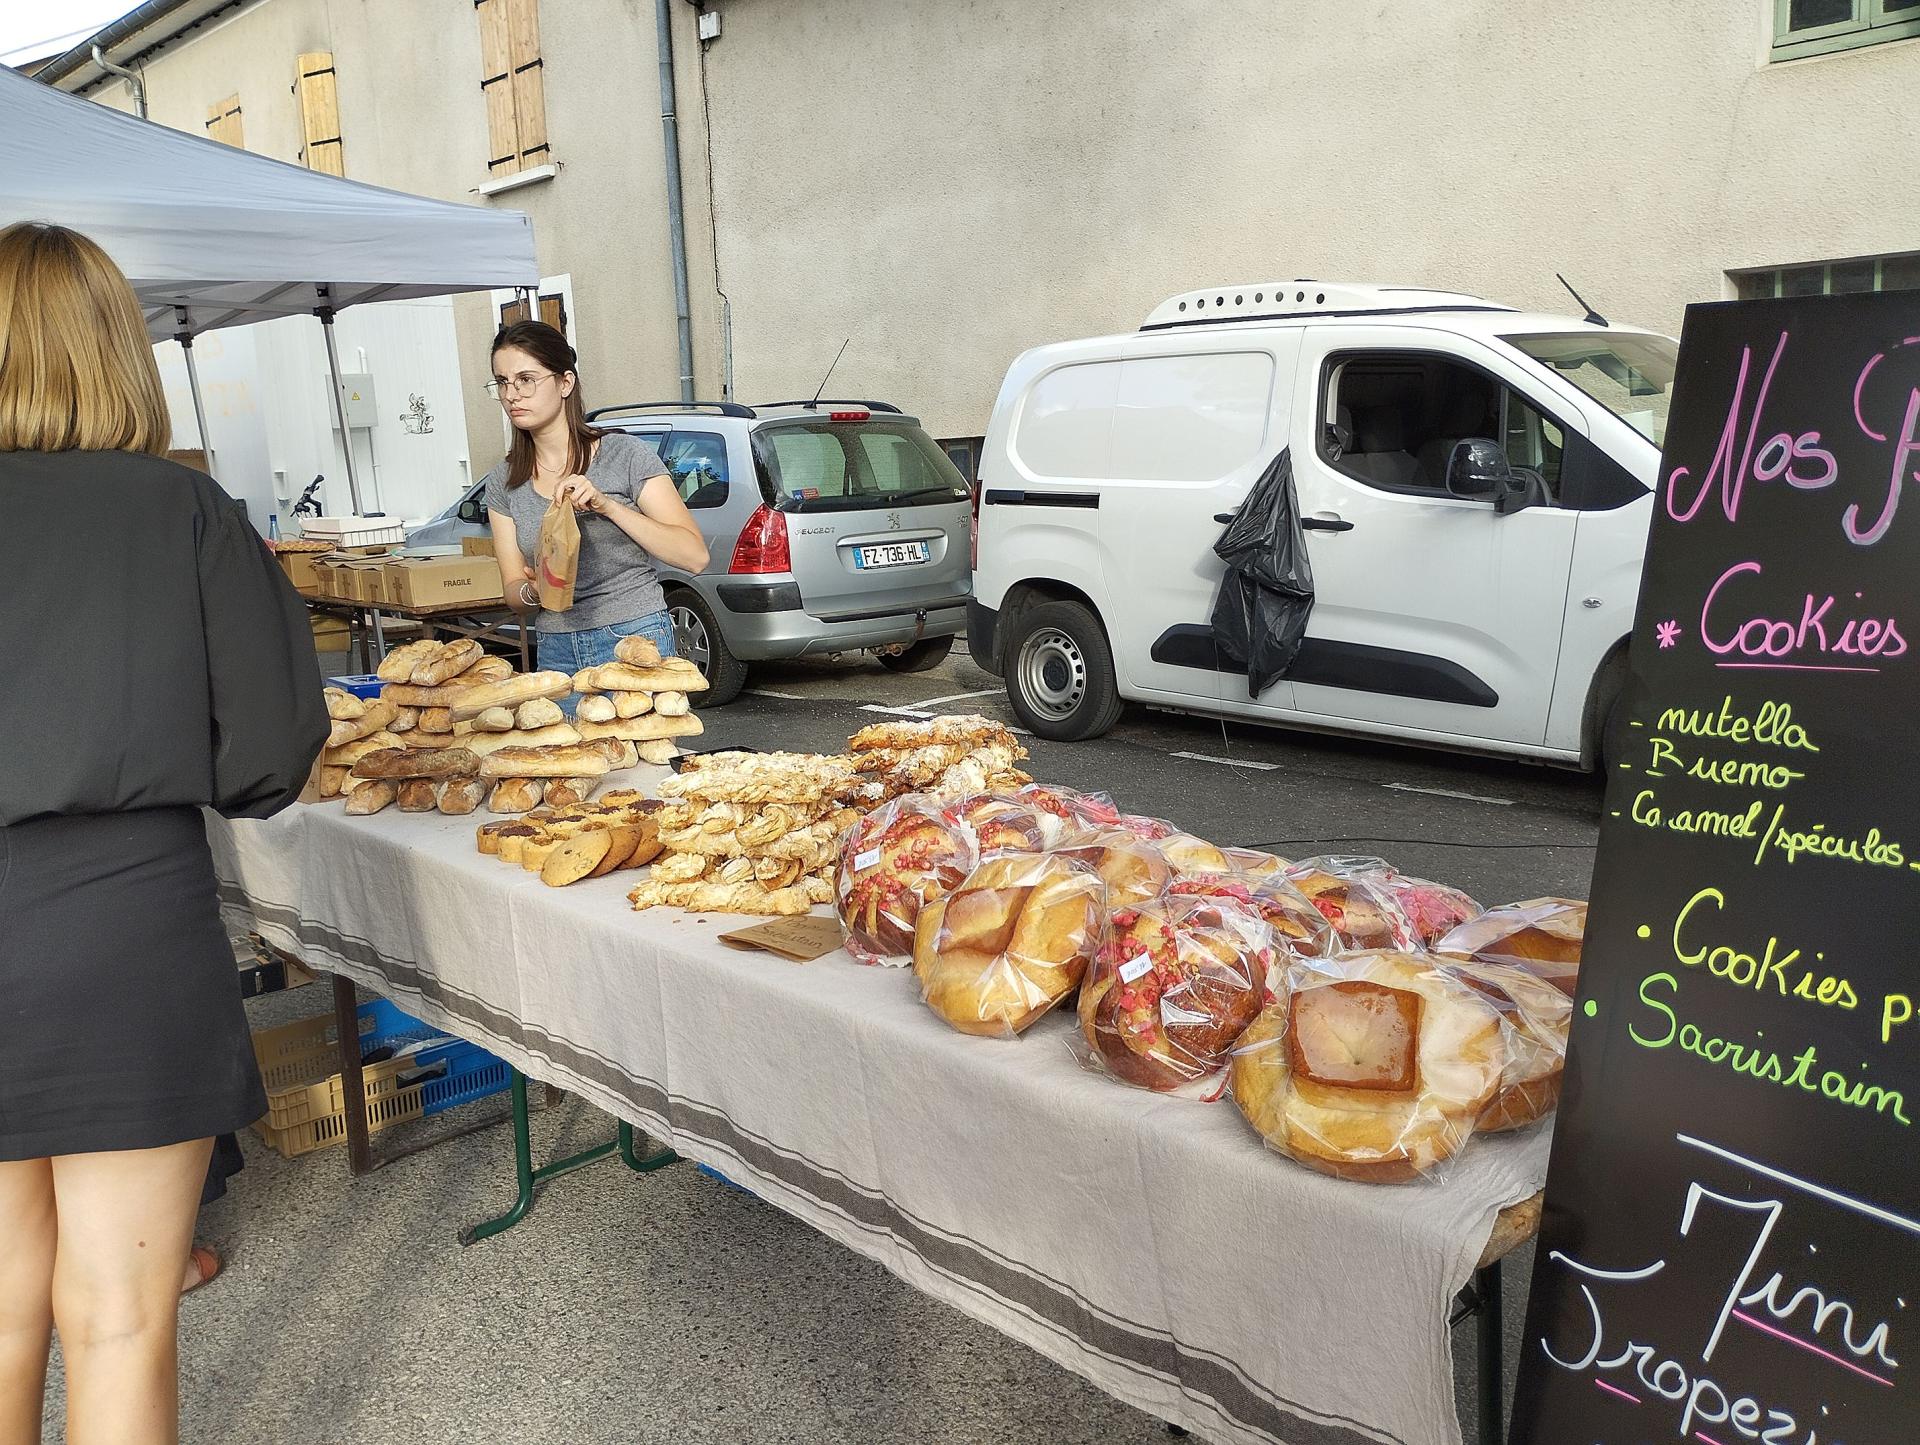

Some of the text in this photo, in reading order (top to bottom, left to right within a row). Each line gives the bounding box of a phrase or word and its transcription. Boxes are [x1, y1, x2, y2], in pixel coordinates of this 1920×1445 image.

[1667, 331, 1838, 523] Nos
[443, 578, 472, 588] FRAGILE
[795, 526, 836, 536] PEUGEOT
[1701, 562, 1907, 657] Cookies
[1673, 888, 1858, 1008] Cookies
[1629, 973, 1911, 1124] Sacristain
